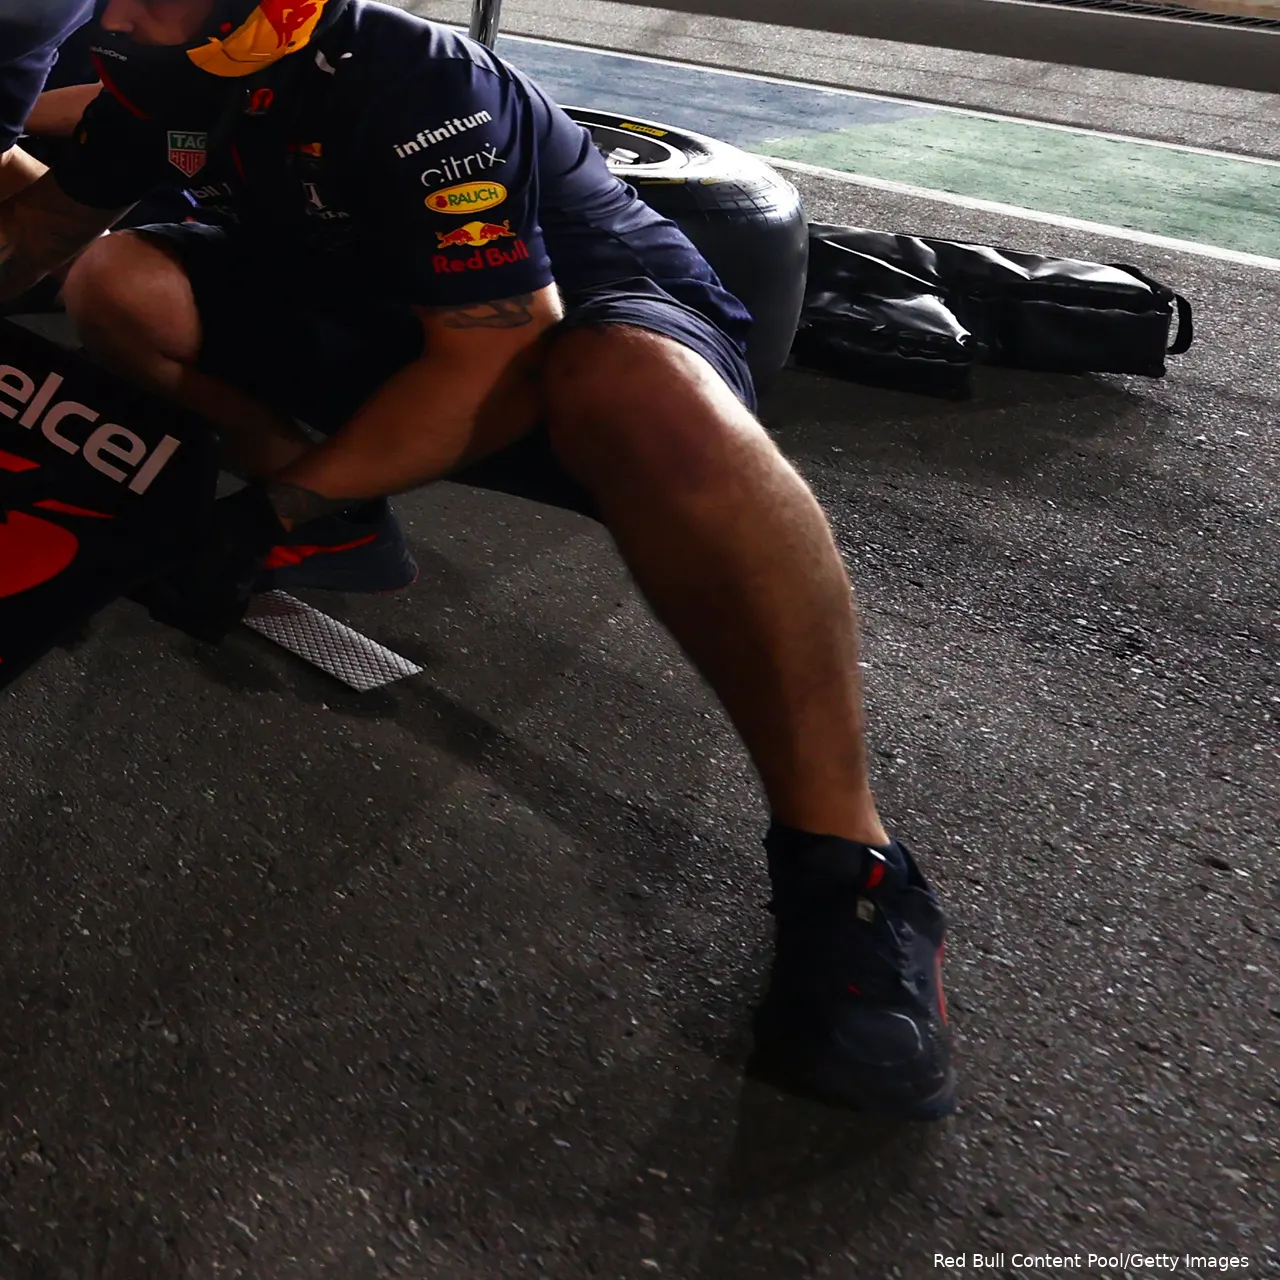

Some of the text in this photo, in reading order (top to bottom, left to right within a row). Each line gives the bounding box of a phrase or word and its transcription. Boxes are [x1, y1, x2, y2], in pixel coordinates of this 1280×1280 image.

[173, 134, 207, 149] TAG
[393, 109, 492, 158] infinitum
[421, 143, 506, 187] citrix
[448, 188, 499, 206] RAUCH
[432, 239, 530, 274] Red Bull
